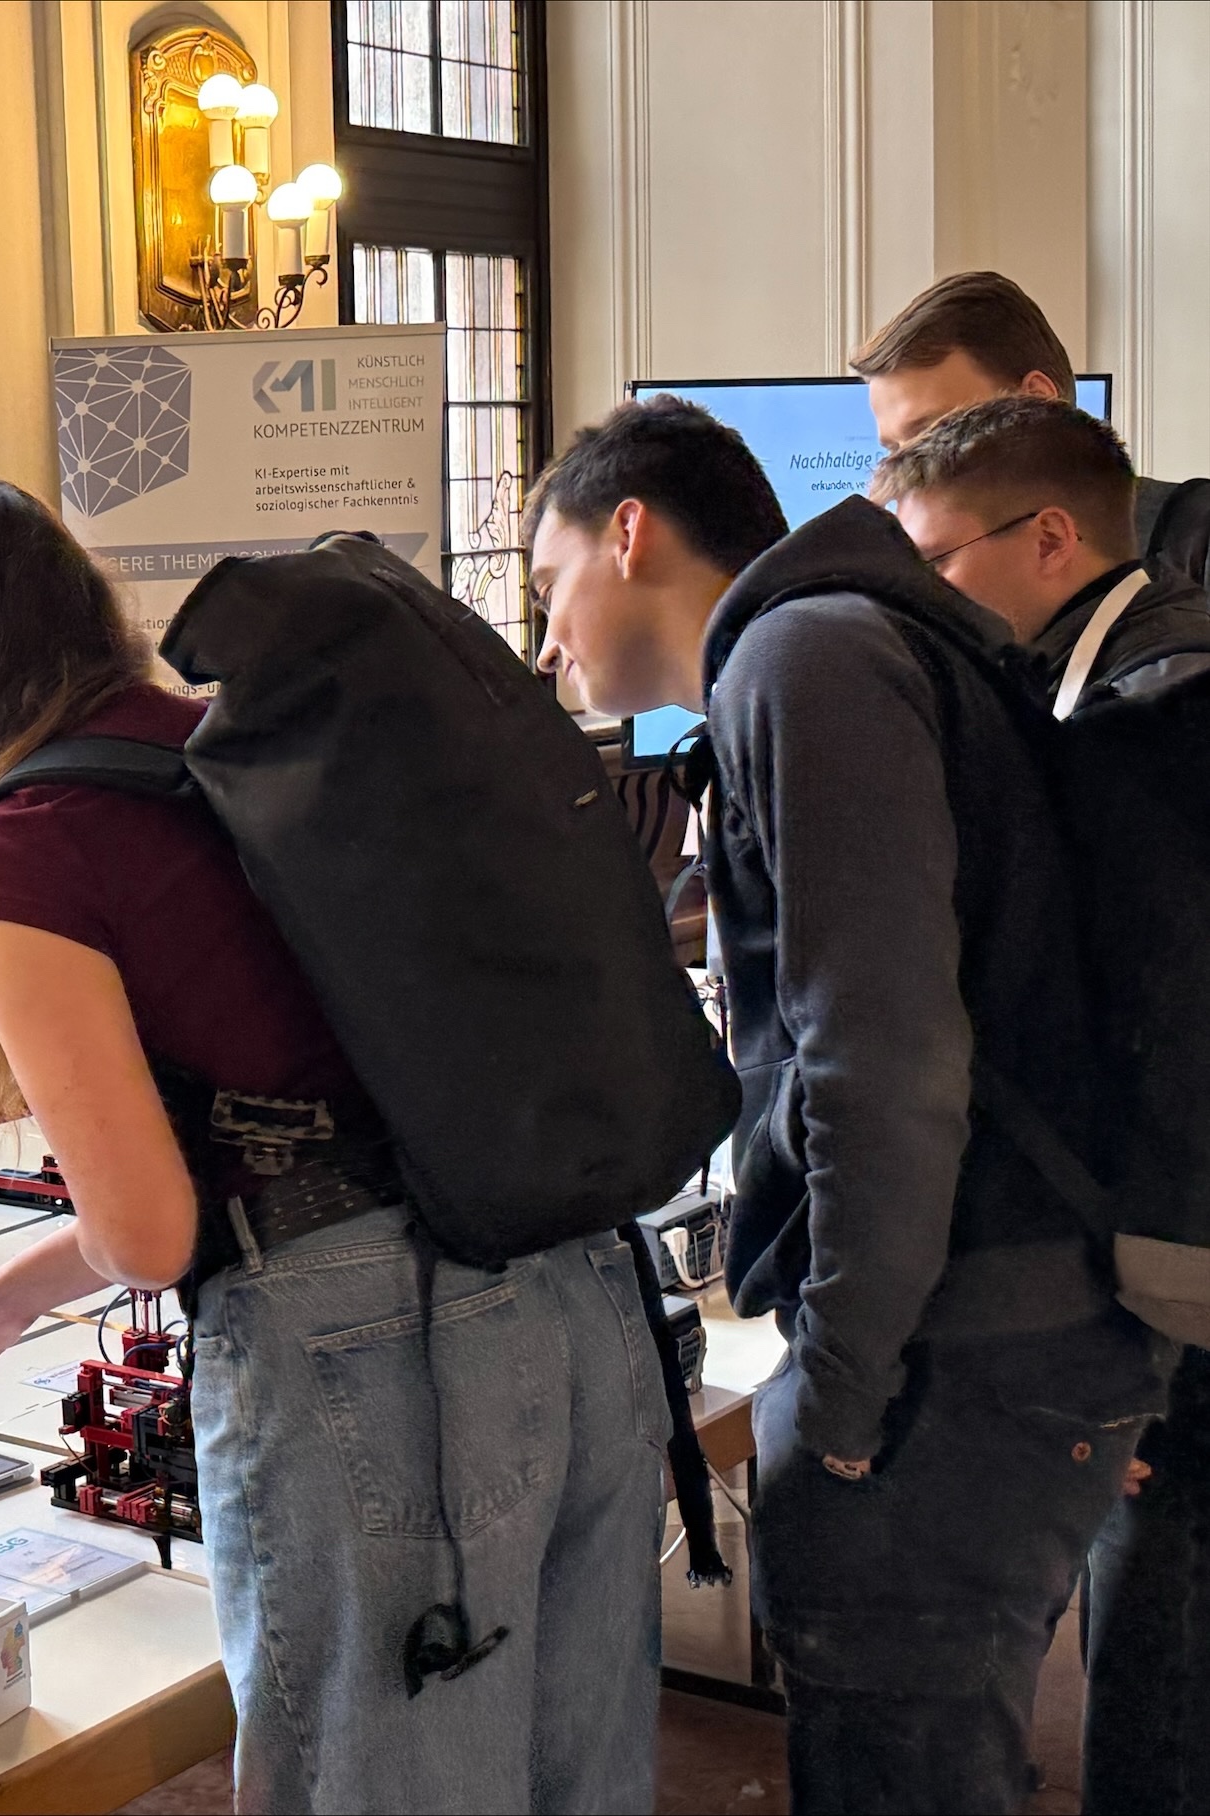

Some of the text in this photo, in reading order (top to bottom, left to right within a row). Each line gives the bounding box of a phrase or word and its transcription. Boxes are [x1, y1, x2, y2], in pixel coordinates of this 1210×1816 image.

[356, 354, 425, 368] KÜNSTLICH
[348, 375, 425, 389] MENSCHLICH
[348, 396, 423, 410] INTELLIGENT
[253, 417, 425, 439] KOMPETENZZENTRUM
[790, 450, 872, 470] Nachhaltige
[254, 464, 350, 480] KI-Expertise mit
[255, 477, 416, 496] arbeitswissenschaftlicher &
[255, 495, 419, 512] soziologischer Fachkenntnis
